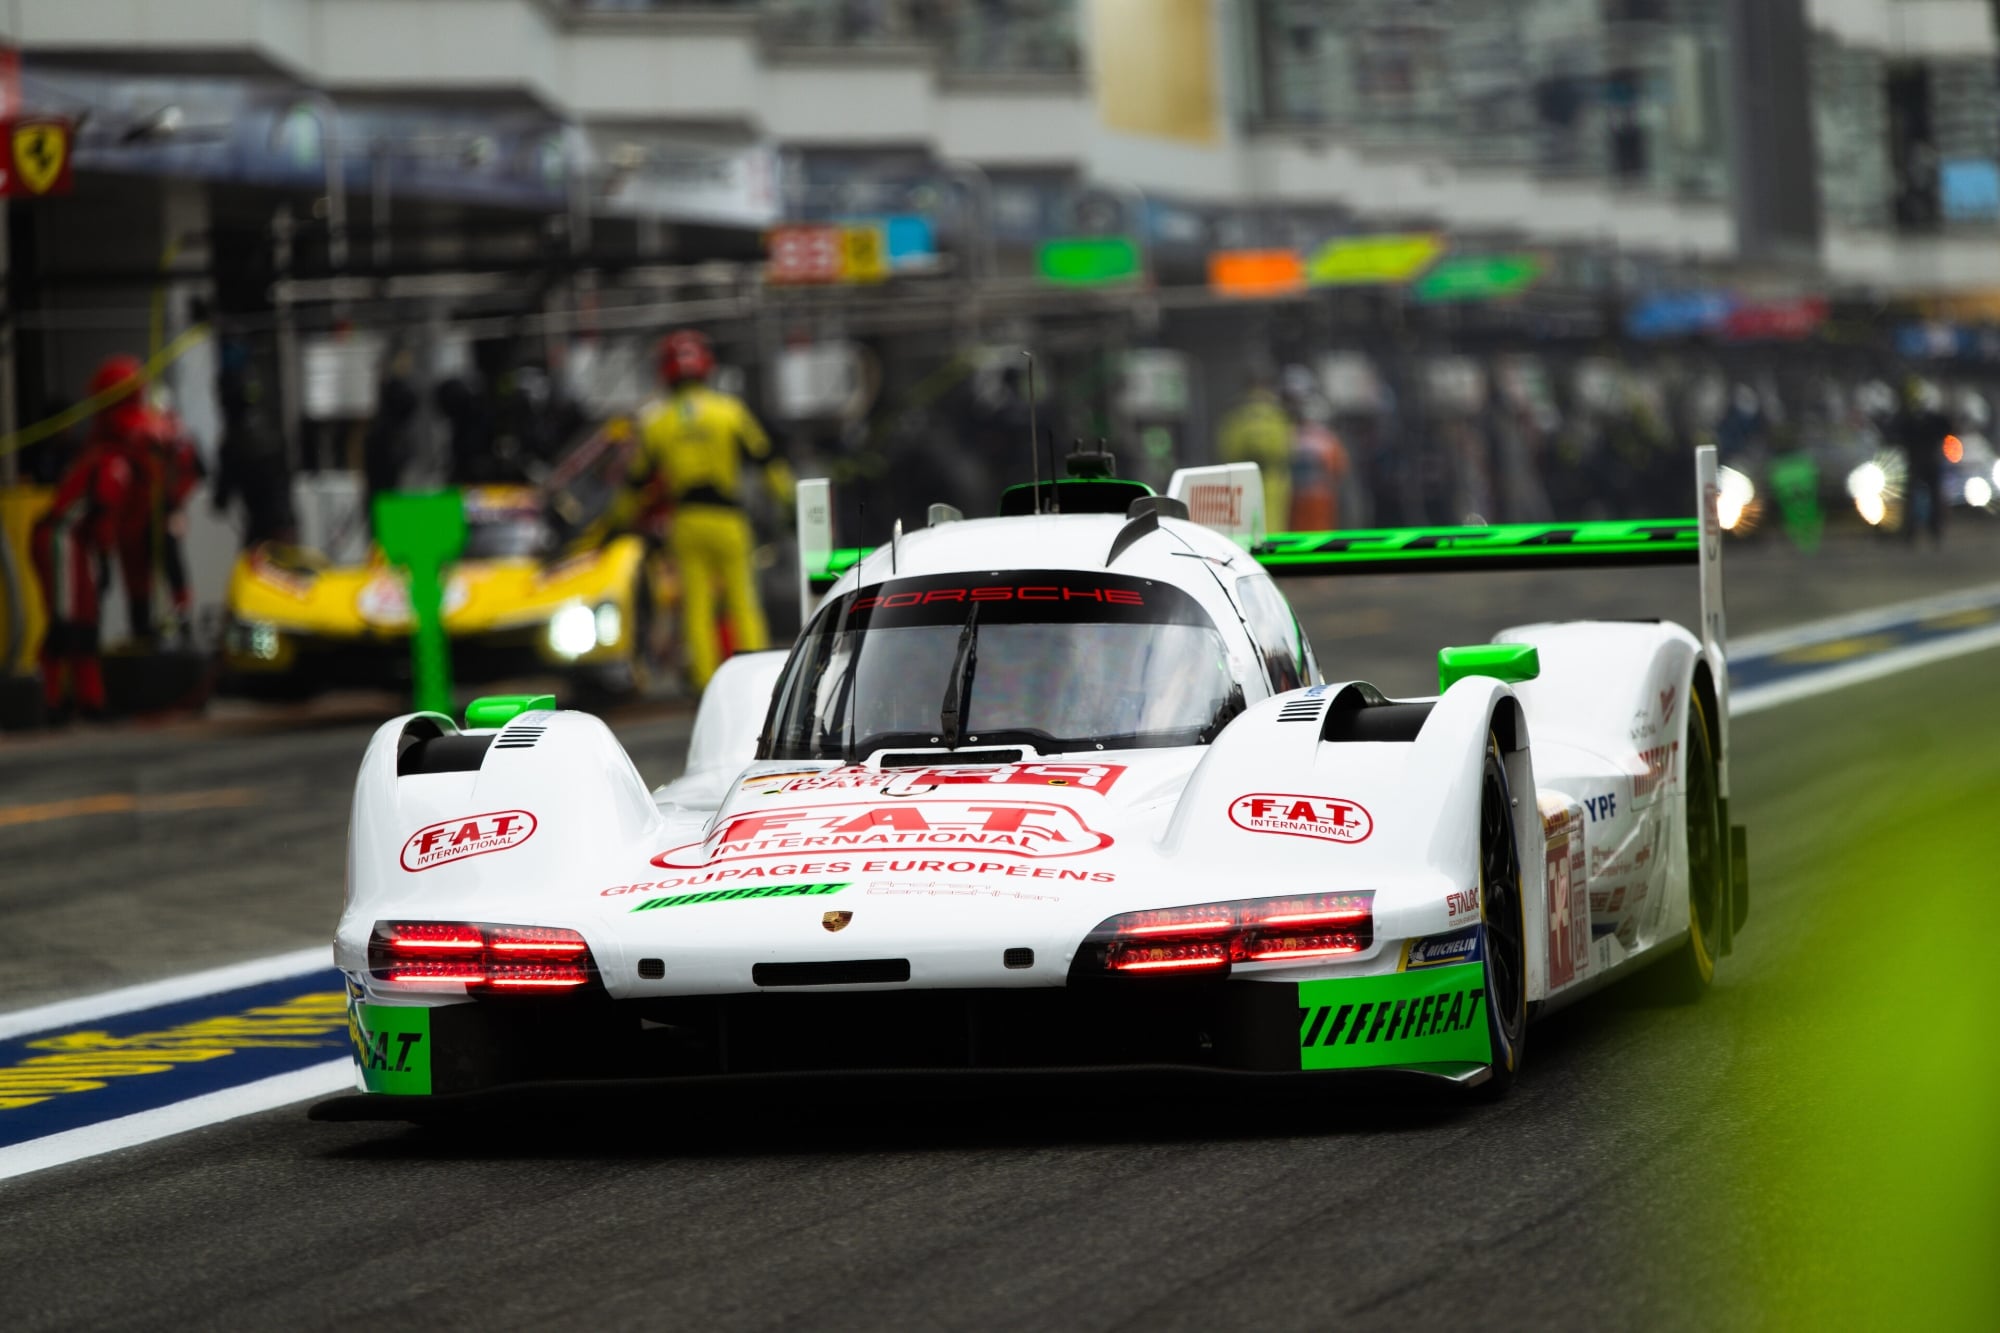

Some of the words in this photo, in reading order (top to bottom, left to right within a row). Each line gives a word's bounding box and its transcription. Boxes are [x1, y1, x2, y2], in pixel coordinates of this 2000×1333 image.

[848, 586, 1145, 613] PORSCHE
[1584, 792, 1617, 823] YPF
[1250, 818, 1354, 838] INTERNATIONAL
[417, 837, 514, 866] INTERNATIONAL
[711, 832, 1039, 859] INTERNATIONAL
[600, 861, 852, 897] GROUPAGES
[862, 860, 1117, 883] EUROPÉENS
[1426, 936, 1478, 958] MICHELIN
